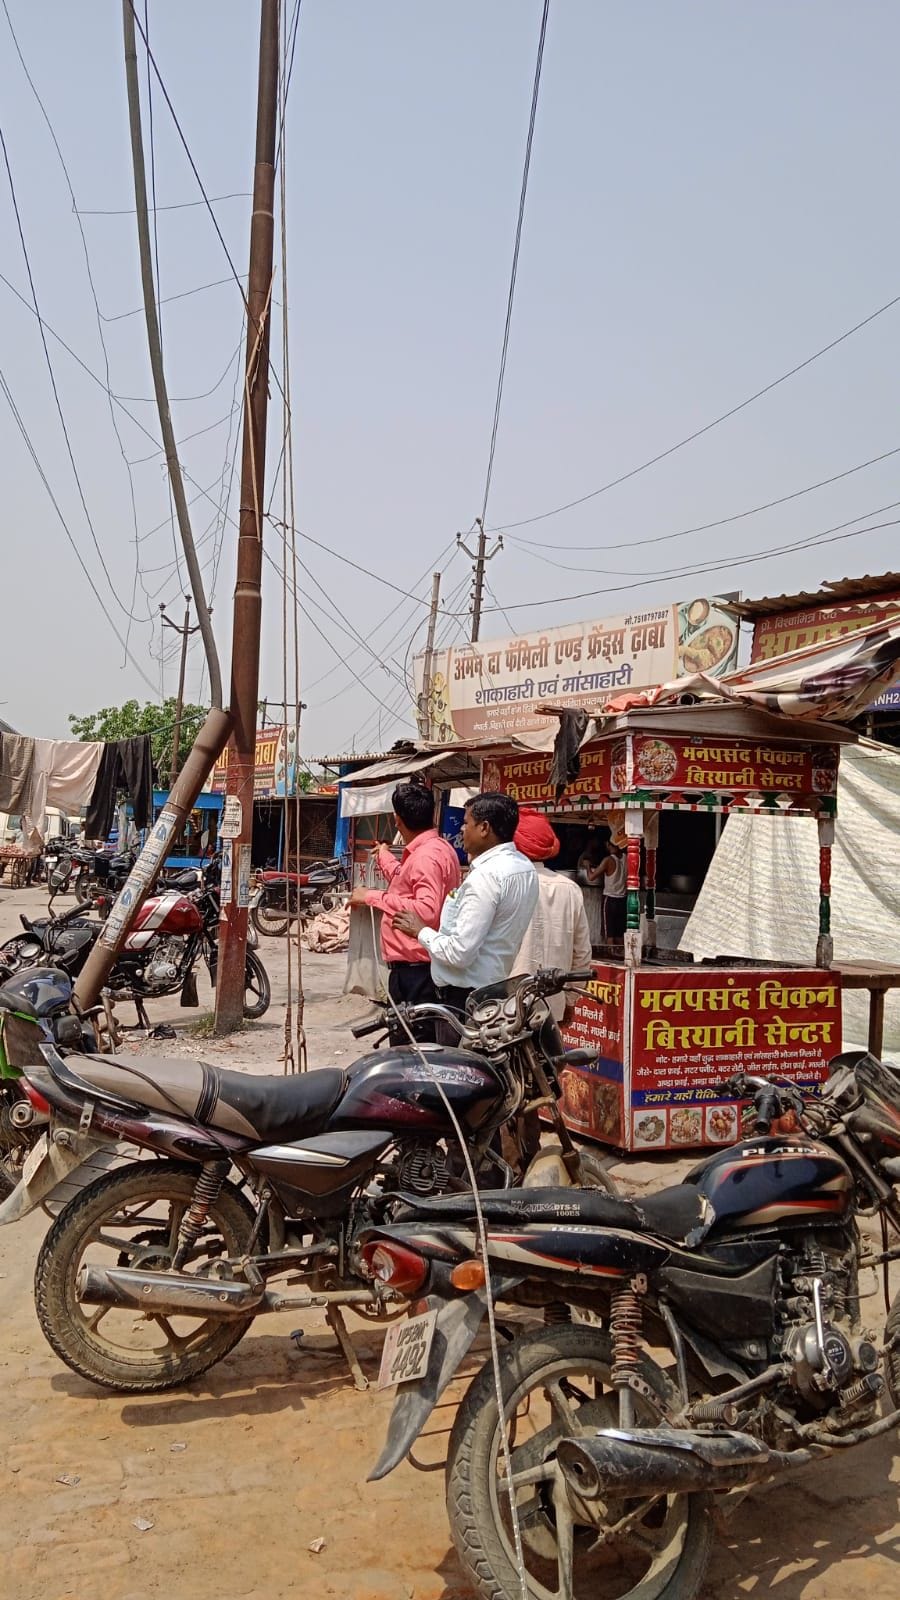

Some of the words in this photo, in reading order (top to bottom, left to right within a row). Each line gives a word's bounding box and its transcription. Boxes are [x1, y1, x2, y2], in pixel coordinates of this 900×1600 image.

[454, 653, 485, 681] अमन
[487, 649, 502, 675] दा
[554, 635, 584, 664] एण्ड
[475, 678, 535, 704] शाकाहारी
[538, 674, 560, 697] एवं
[562, 663, 633, 692] मांसाहारी
[681, 743, 751, 763] मनपसंद
[754, 747, 807, 766] चिकन
[685, 765, 757, 786] बिरयानी
[760, 768, 804, 788] सेन्टर
[639, 977, 751, 1012] मनपसंद
[756, 980, 839, 1010] चिकन
[642, 1016, 758, 1051] बिरयानी
[763, 1015, 835, 1046] सेन्टर
[390, 1341, 427, 1381] 4492
